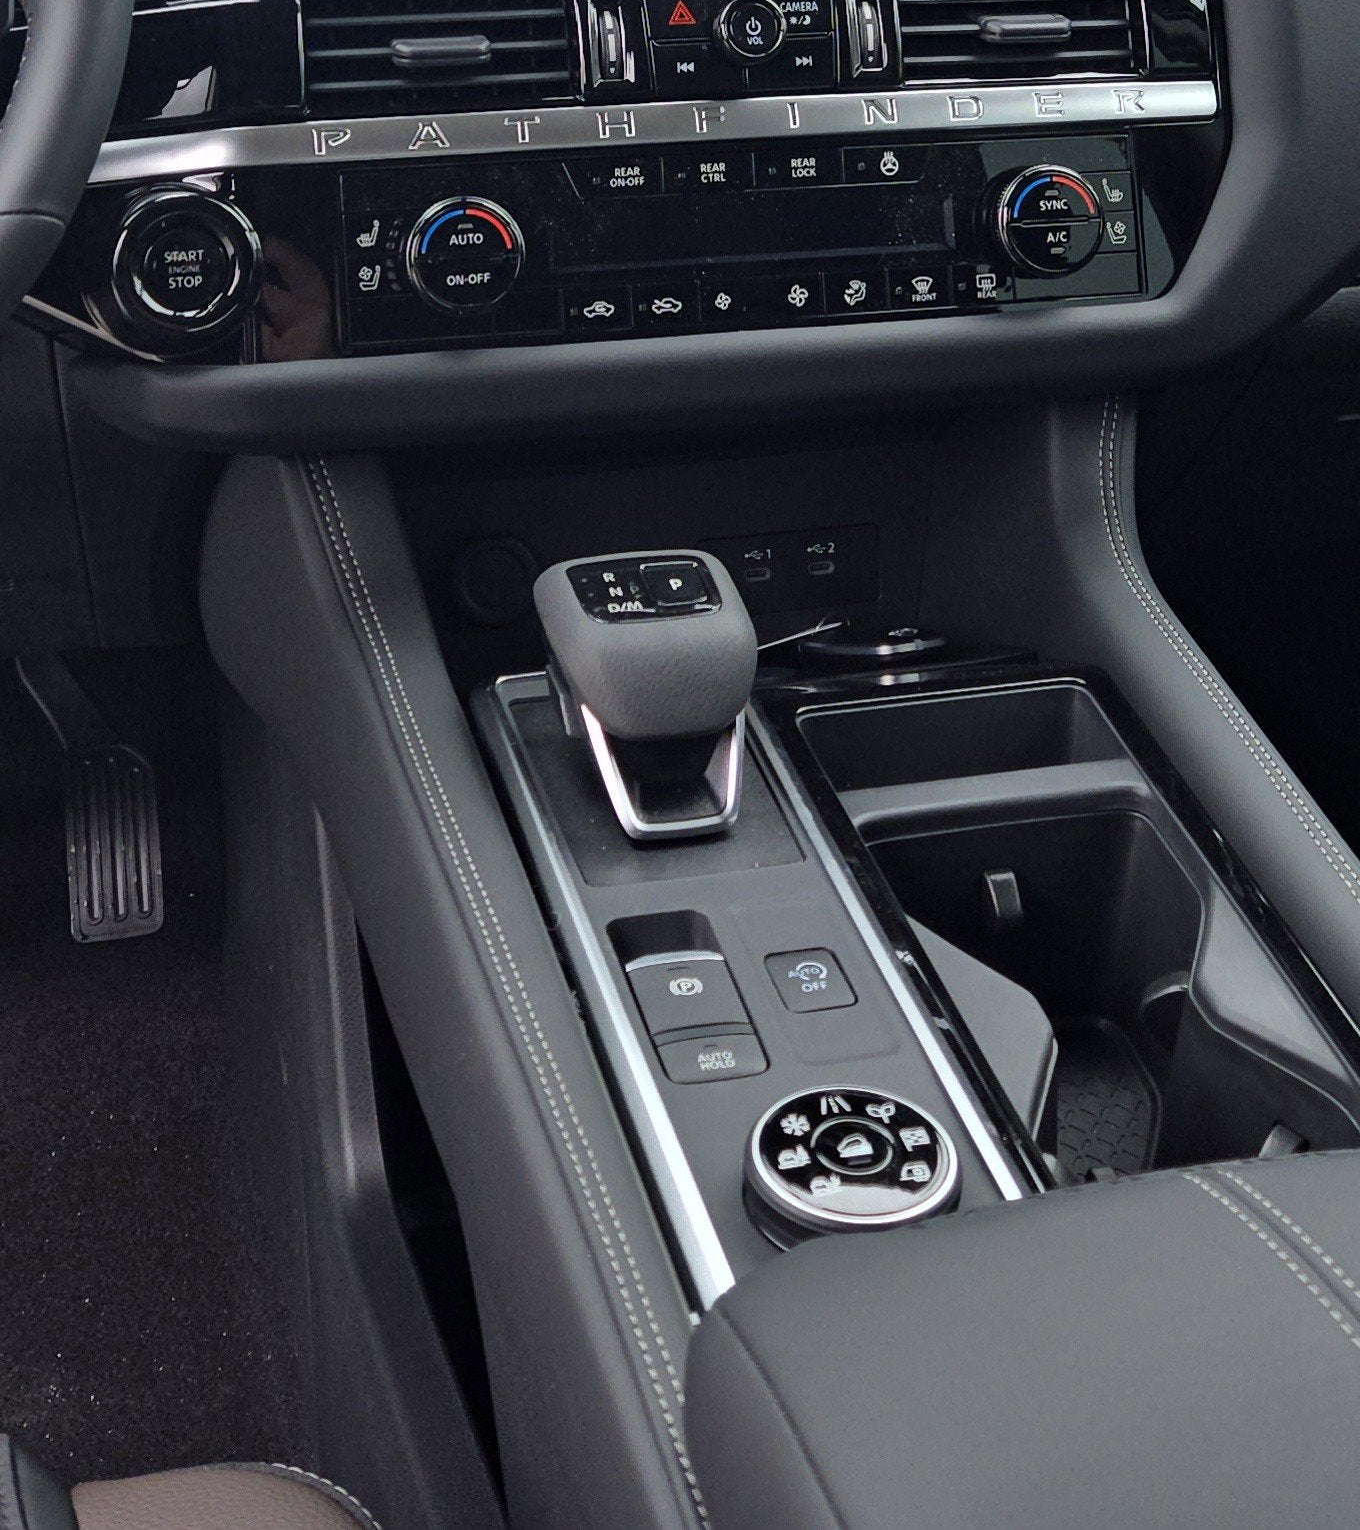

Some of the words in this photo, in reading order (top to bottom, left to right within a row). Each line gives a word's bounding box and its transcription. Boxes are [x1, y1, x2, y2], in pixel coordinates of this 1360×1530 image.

[780, 1, 819, 12] CAMERA
[746, 36, 764, 46] VOL
[311, 88, 1147, 156] PATHFINDER
[700, 162, 726, 173] REAR
[791, 157, 816, 168] REAR
[614, 166, 641, 177] REAR
[700, 172, 727, 183] CTRL
[791, 167, 817, 178] LOCK
[1039, 199, 1069, 211] SYNC
[449, 233, 484, 246] AUTO
[1046, 231, 1068, 244] A/C
[163, 250, 205, 264] START
[168, 264, 201, 275] ENGINE
[168, 275, 203, 289] STOP
[911, 292, 938, 302] FRONT
[977, 291, 998, 299] REAR
[827, 542, 835, 554] 2
[602, 572, 616, 583] R
[668, 578, 683, 591] P
[608, 586, 624, 598] N
[607, 600, 644, 613] D/M
[801, 980, 828, 993] OFF
[697, 1049, 733, 1063] AUTO
[700, 1059, 736, 1071] HOLD
